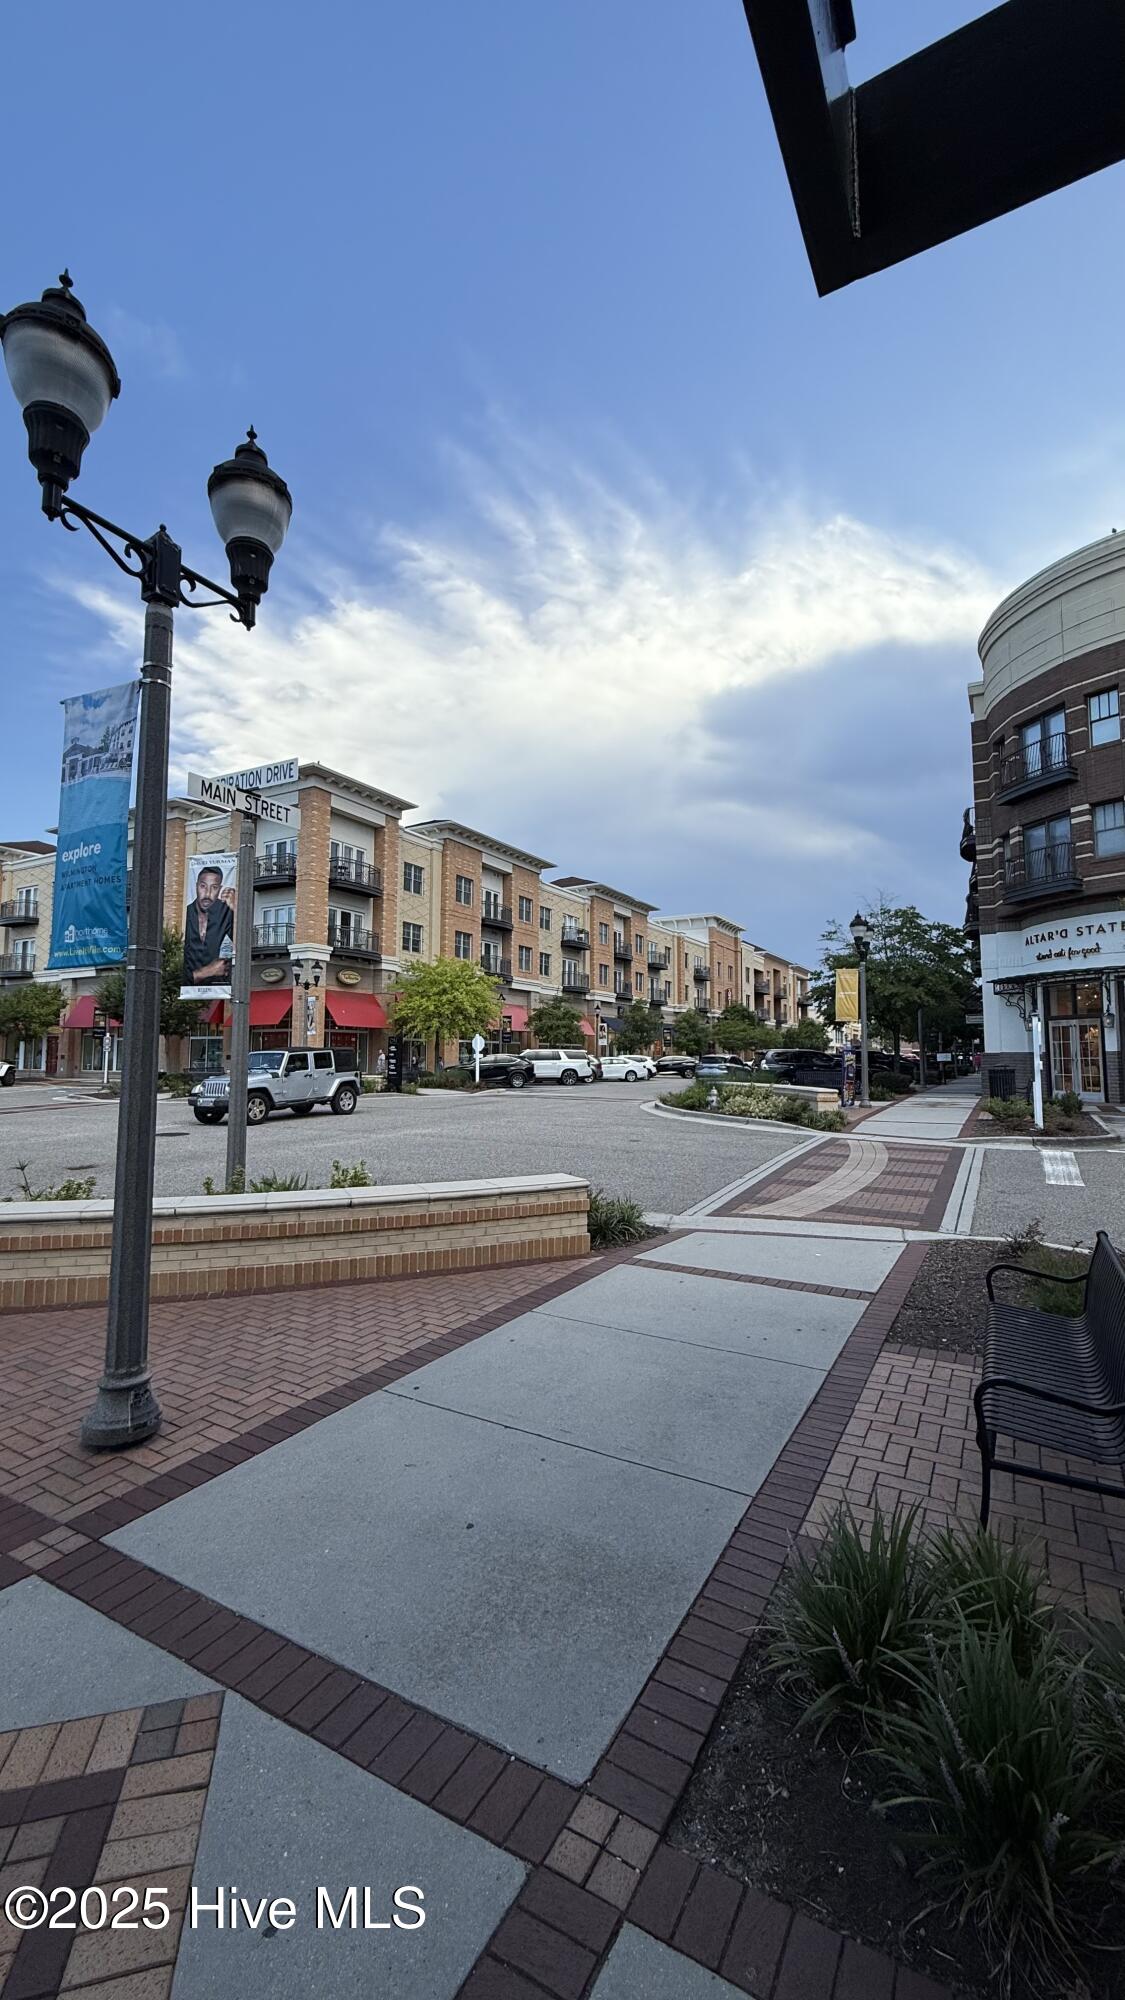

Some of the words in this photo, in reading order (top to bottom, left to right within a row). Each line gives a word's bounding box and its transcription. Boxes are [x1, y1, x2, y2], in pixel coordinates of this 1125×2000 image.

[217, 770, 262, 790] IRATION
[266, 762, 295, 783] DRIVE
[201, 779, 237, 806] MAIN
[244, 795, 291, 823] STREET
[62, 842, 102, 864] explore
[94, 875, 122, 885] HOMES
[1076, 921, 1125, 936] STATE
[1081, 942, 1101, 958] good
